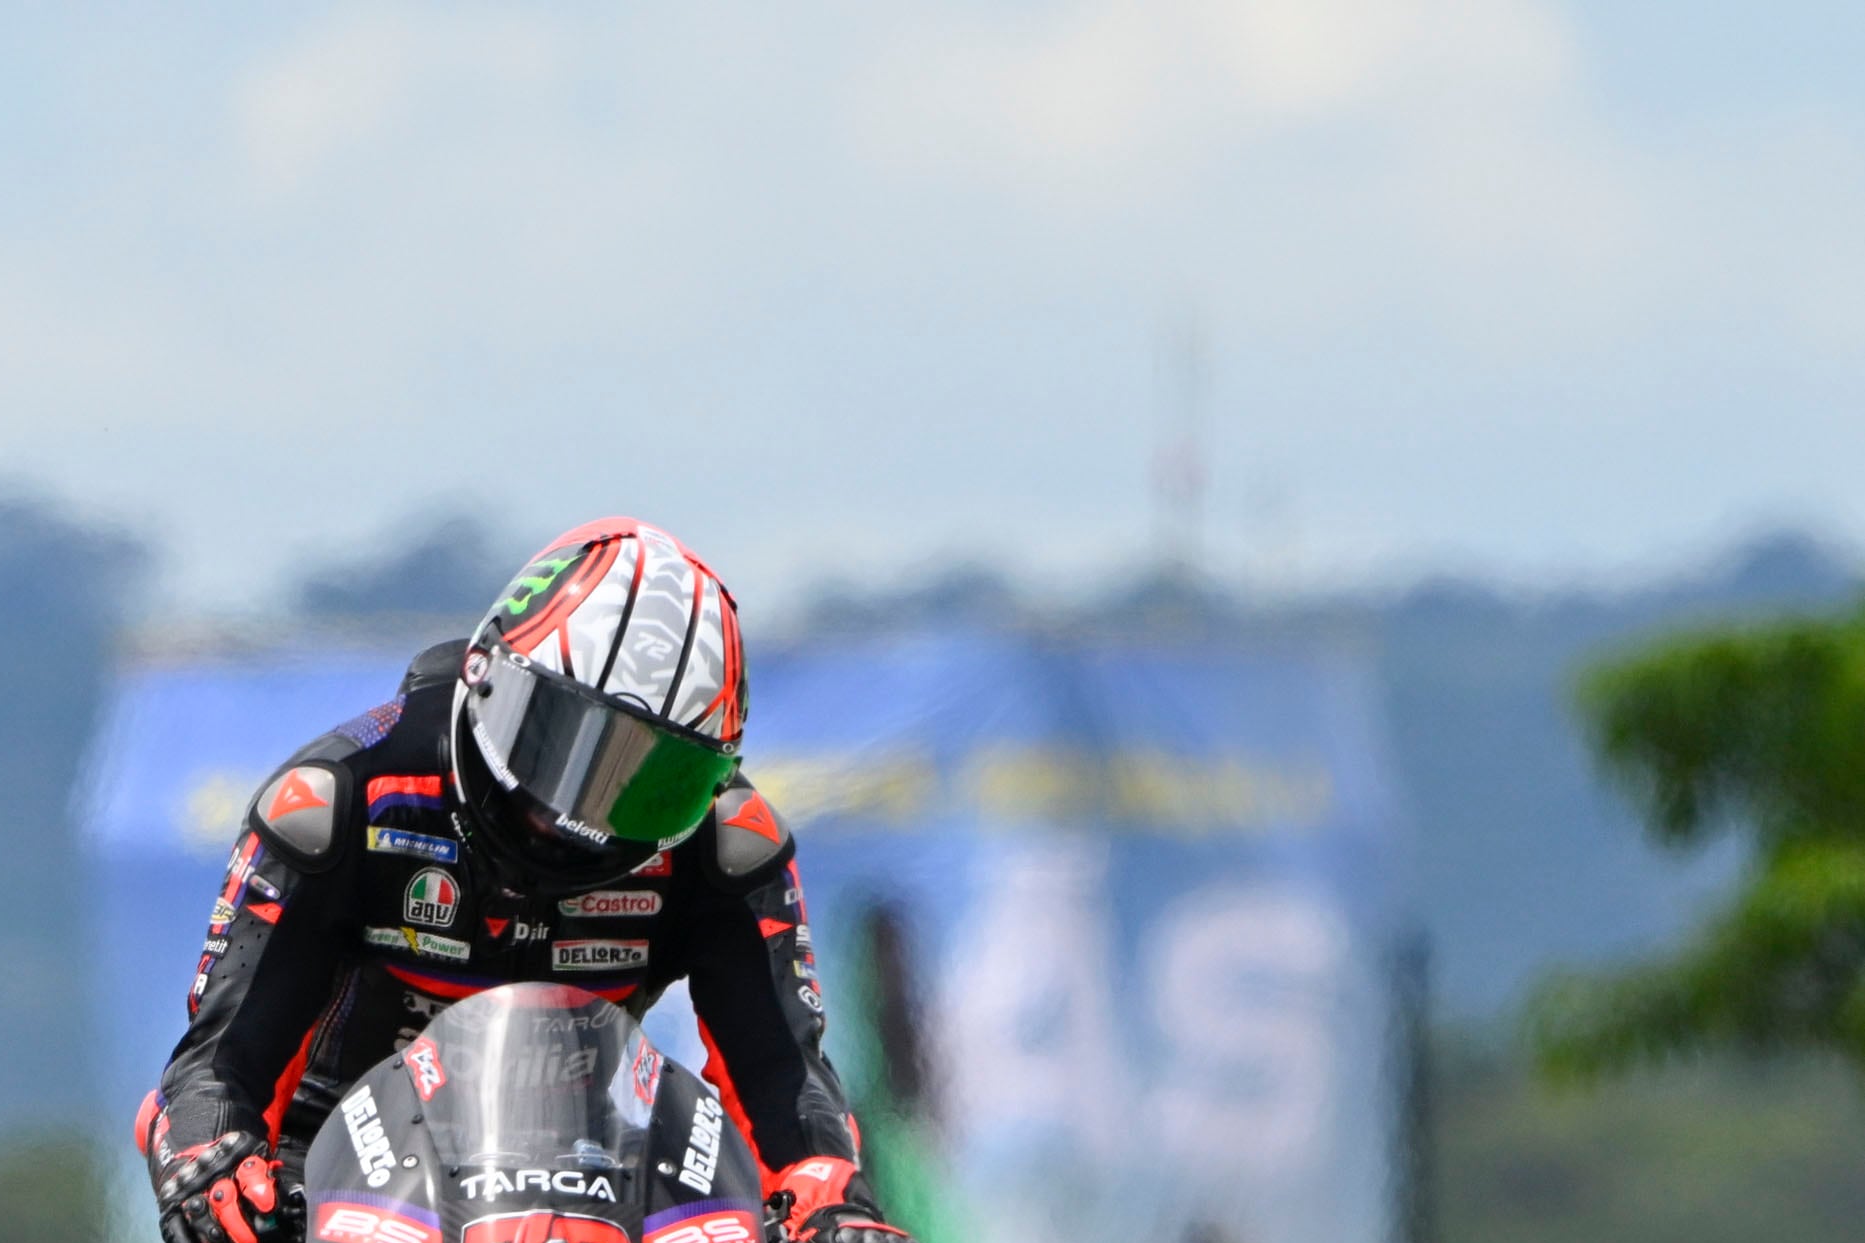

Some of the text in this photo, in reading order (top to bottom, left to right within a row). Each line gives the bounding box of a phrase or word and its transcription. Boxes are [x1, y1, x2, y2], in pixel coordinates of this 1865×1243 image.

[634, 631, 673, 662] 72
[555, 812, 610, 845] belotti
[410, 900, 451, 924] agv
[581, 894, 656, 913] Castrol
[422, 936, 465, 955] Power
[460, 1169, 617, 1202] TARGA
